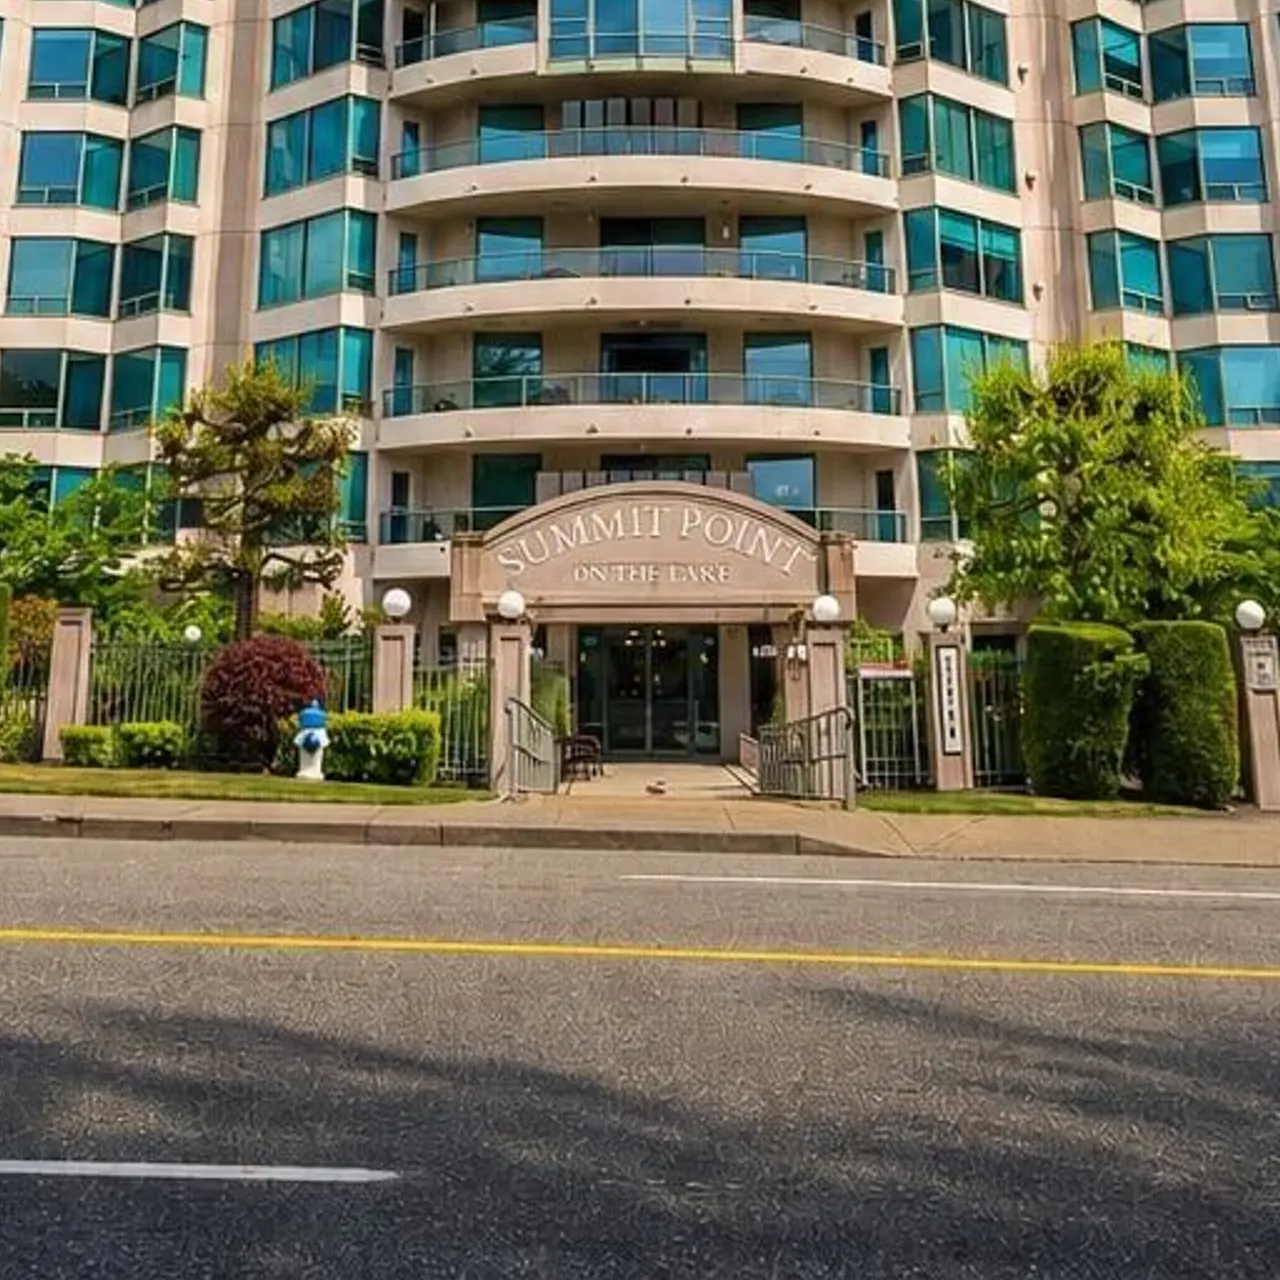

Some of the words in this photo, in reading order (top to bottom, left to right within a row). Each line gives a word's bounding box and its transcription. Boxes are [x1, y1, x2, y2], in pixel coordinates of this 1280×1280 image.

[497, 504, 671, 576] SUMMIT
[679, 505, 819, 576] POINT
[573, 562, 608, 582] ON
[611, 562, 661, 582] THE
[668, 562, 733, 582] LAKE
